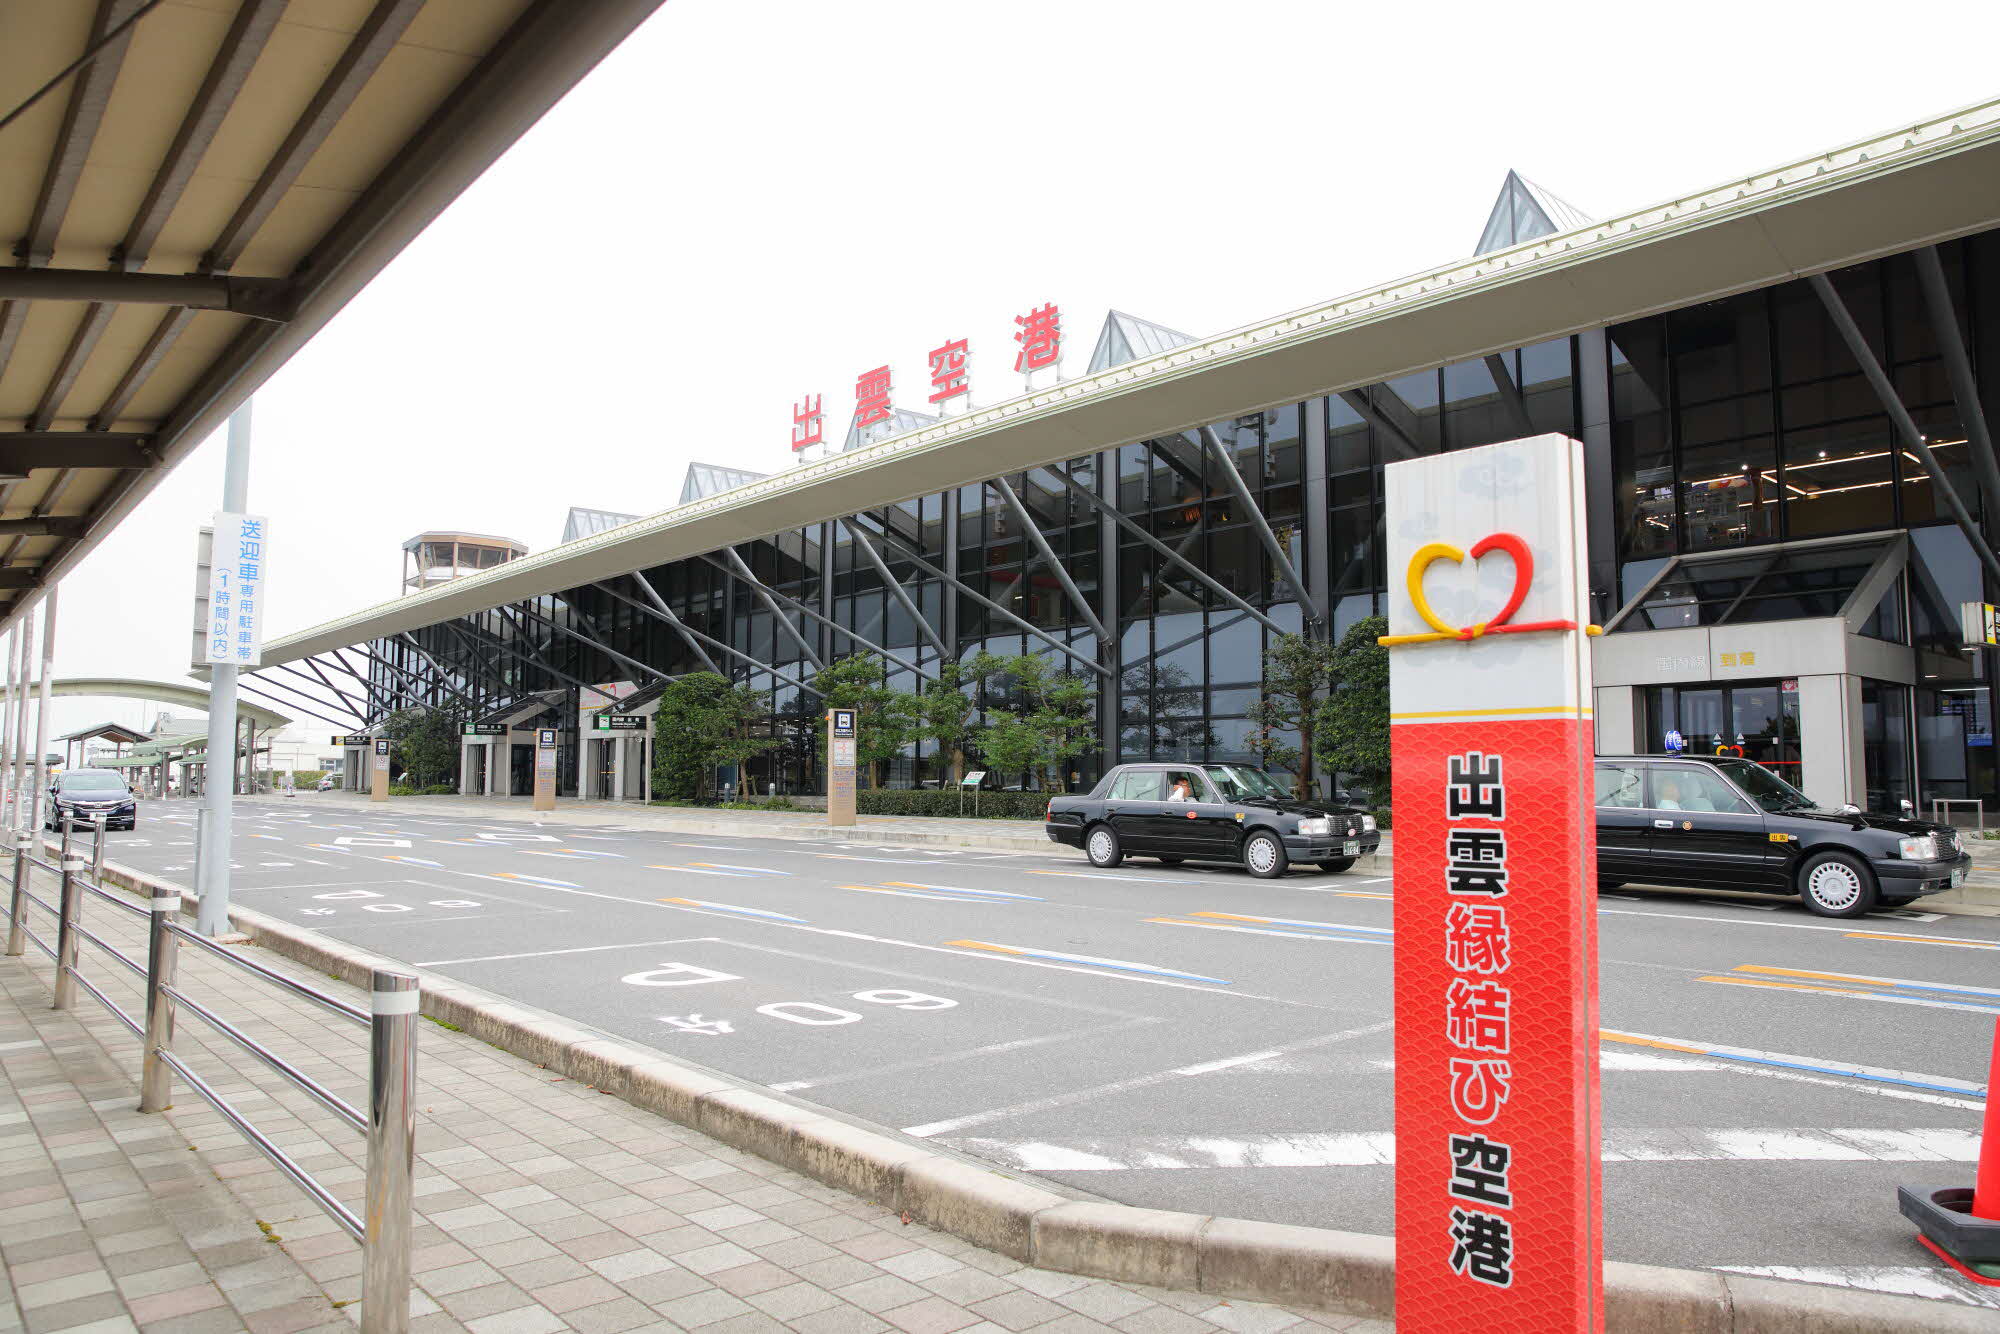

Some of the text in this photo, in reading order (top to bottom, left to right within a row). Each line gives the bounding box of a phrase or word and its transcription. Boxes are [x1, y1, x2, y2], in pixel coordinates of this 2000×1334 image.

[792, 302, 1060, 453] 出雲空港
[238, 519, 262, 660] 送迎車専用駐車帯
[621, 962, 746, 987] P
[1445, 751, 1513, 1289] 出雲縁結び空港
